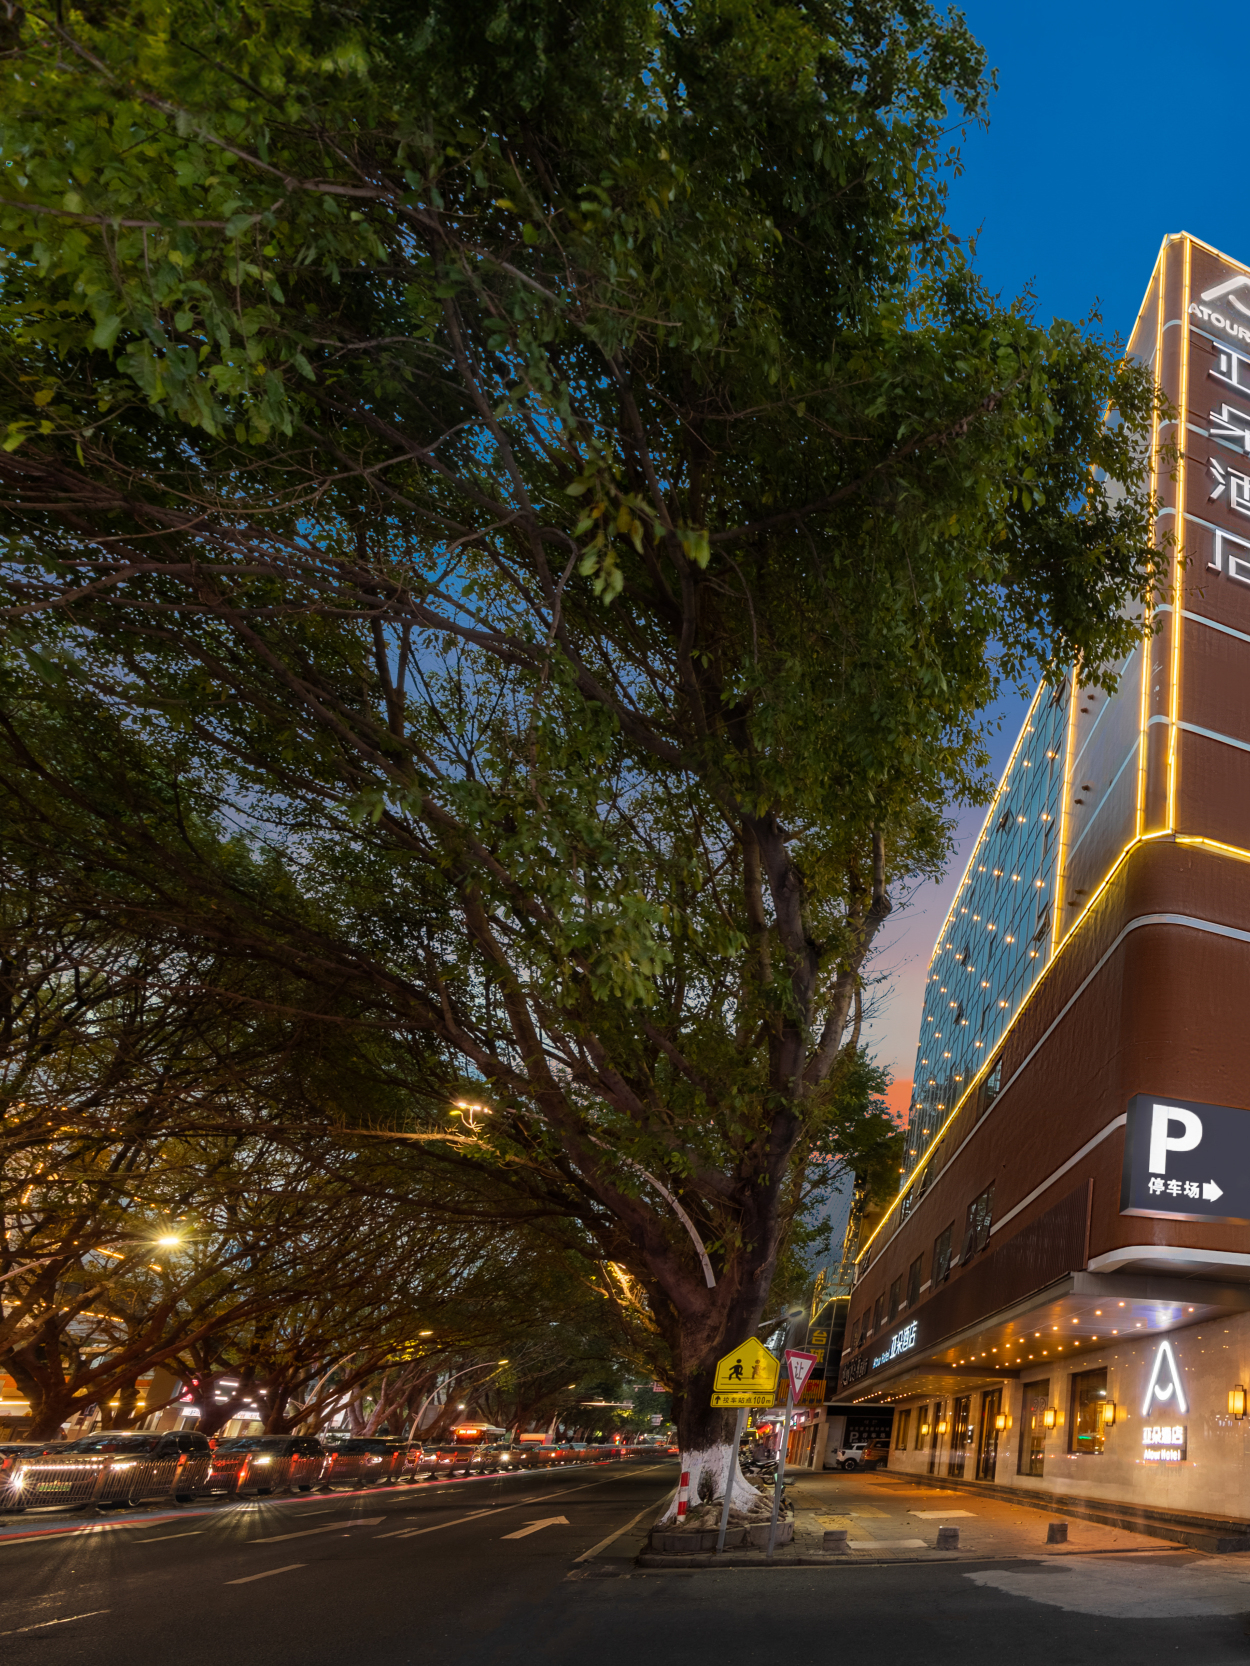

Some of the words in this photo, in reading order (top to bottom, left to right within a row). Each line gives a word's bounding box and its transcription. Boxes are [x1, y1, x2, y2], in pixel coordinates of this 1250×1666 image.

[1148, 1103, 1203, 1175] P
[1148, 1177, 1200, 1200] 停车场
[794, 1361, 804, 1380] 让
[1142, 1425, 1184, 1445] 亚朵酒店
